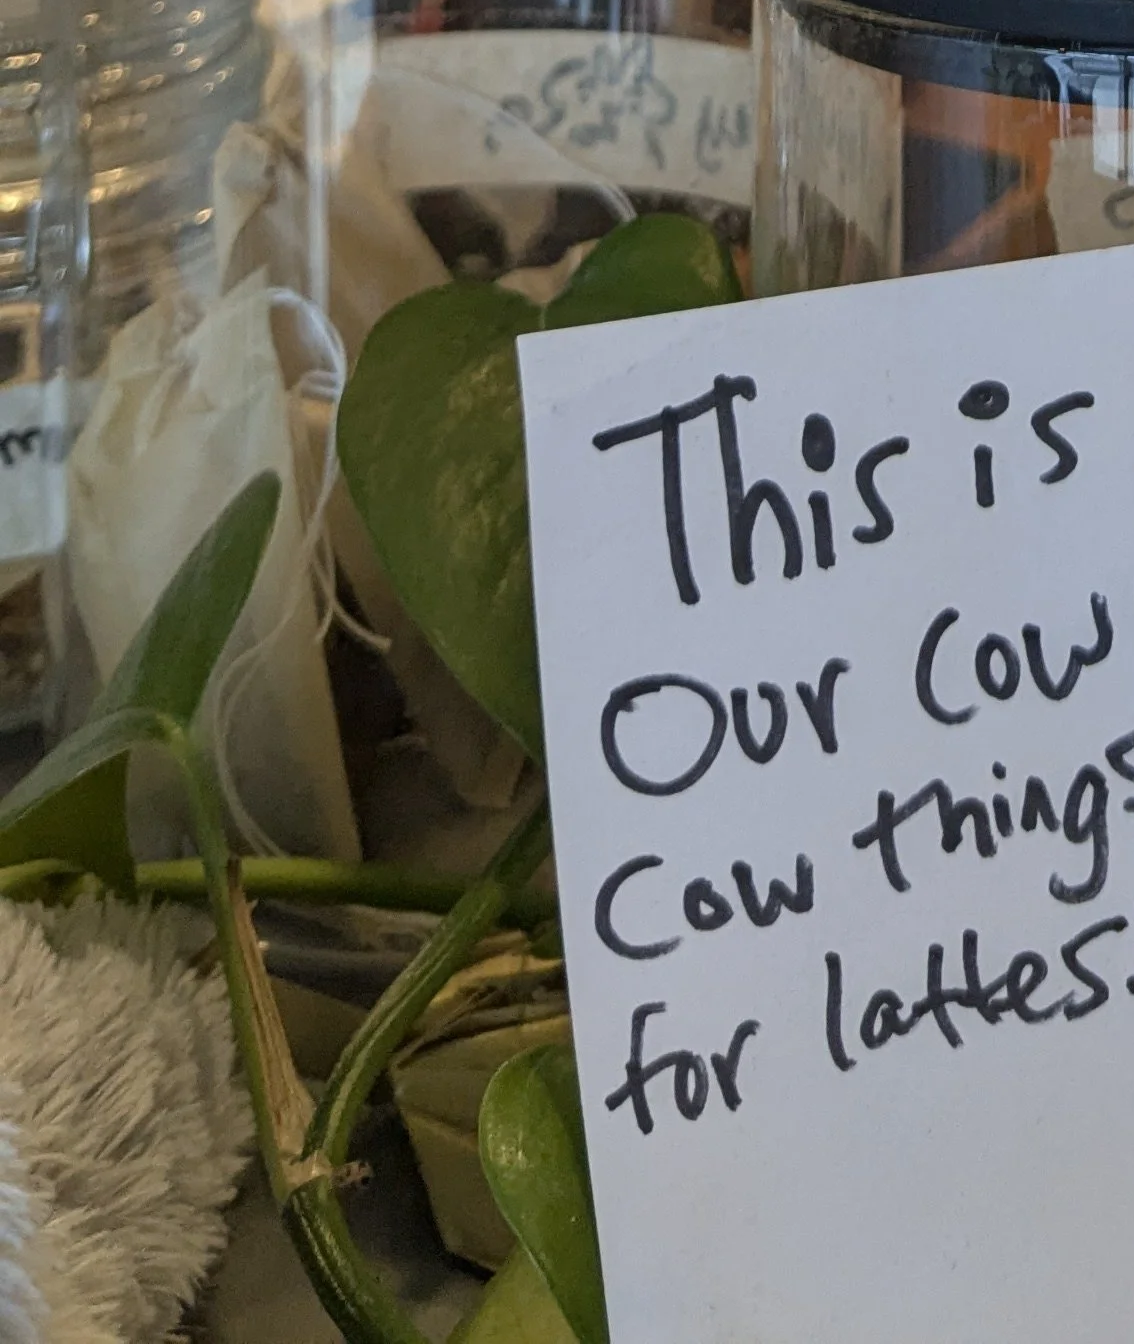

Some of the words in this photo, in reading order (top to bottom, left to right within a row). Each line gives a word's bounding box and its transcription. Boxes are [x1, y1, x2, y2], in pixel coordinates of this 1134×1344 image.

[592, 374, 910, 606] This
[958, 379, 1094, 509] is
[601, 656, 852, 797] Our
[604, 1000, 761, 1135] for
